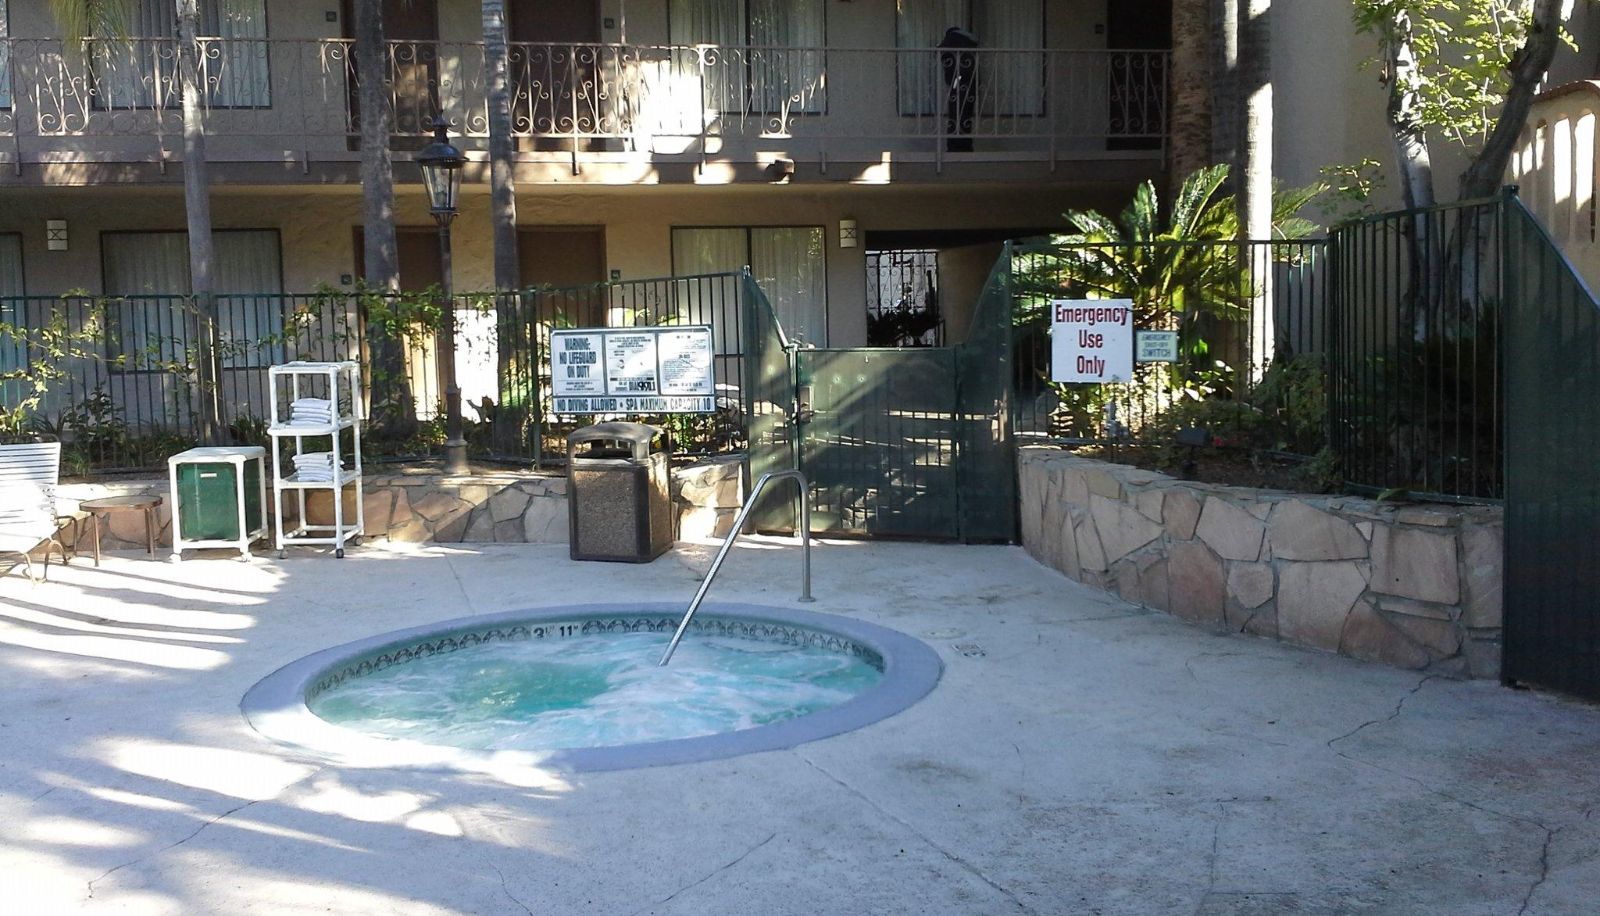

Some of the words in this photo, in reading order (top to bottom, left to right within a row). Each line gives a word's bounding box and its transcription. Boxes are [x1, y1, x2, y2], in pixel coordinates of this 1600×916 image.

[1055, 304, 1128, 326] Emergency
[1079, 329, 1103, 348] Use
[559, 351, 567, 365] NO
[568, 350, 597, 365] LIFEGUARD
[1077, 355, 1105, 377] Only
[567, 365, 575, 378] ON
[576, 365, 590, 378] DUTY
[557, 399, 566, 411] NO
[568, 399, 589, 411] DIVING
[591, 398, 618, 411] ALLOWED
[626, 398, 638, 411] SPA
[640, 398, 667, 411] MAXIMUM
[703, 397, 711, 411] 10
